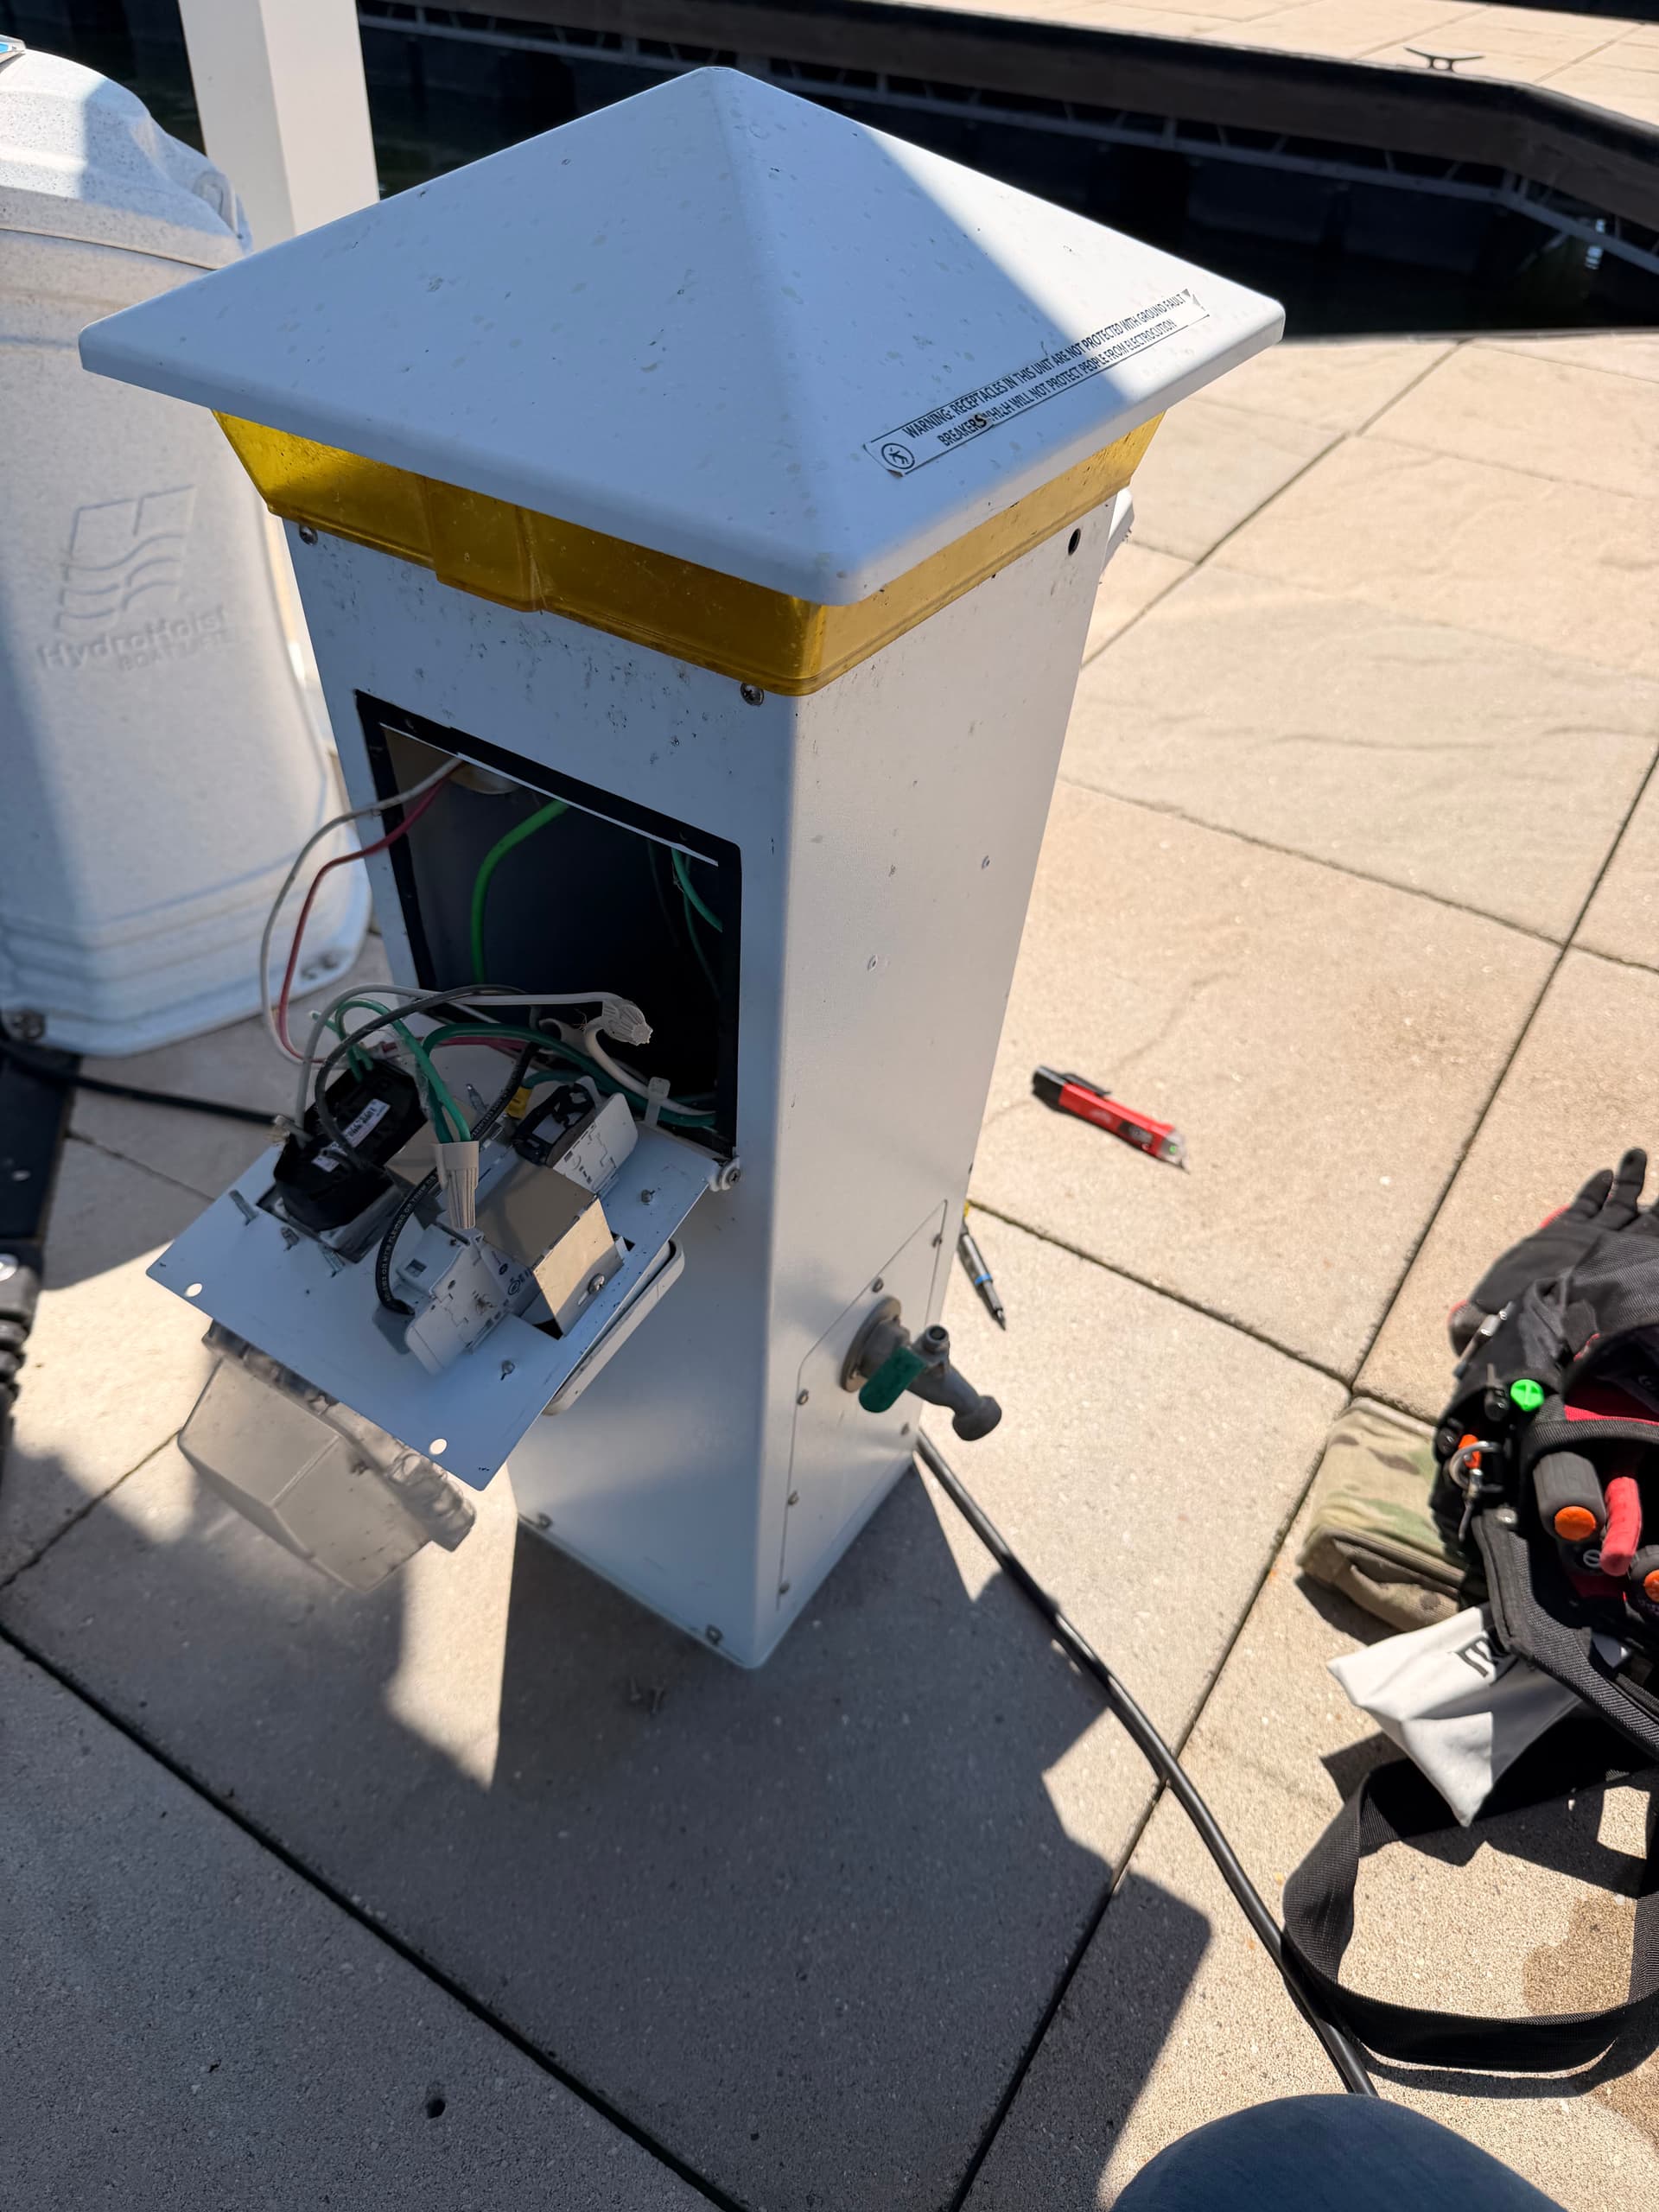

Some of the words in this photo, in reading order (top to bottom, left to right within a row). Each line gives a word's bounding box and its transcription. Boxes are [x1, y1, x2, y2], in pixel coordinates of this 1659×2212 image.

[902, 409, 956, 439] WARNING:
[950, 381, 1008, 416] RECEPTACLES
[1002, 376, 1019, 390] IN
[1012, 366, 1036, 384] THIS
[1031, 358, 1055, 375] UNIT
[1051, 351, 1071, 365] ARE
[1065, 342, 1086, 359] NOT
[1081, 323, 1123, 352] PROTECTED
[1119, 316, 1141, 332] WITH
[1136, 301, 1167, 323] GROUND
[1163, 294, 1186, 311] FAULT
[937, 414, 987, 447] BREAKERS
[1008, 392, 1035, 409] WILL
[1028, 383, 1051, 400] NOT
[1046, 366, 1084, 391] PROTECT
[1078, 354, 1109, 374] PEOPLE
[1103, 343, 1129, 361] FROM
[1124, 319, 1177, 351] ELECTROCUTION
